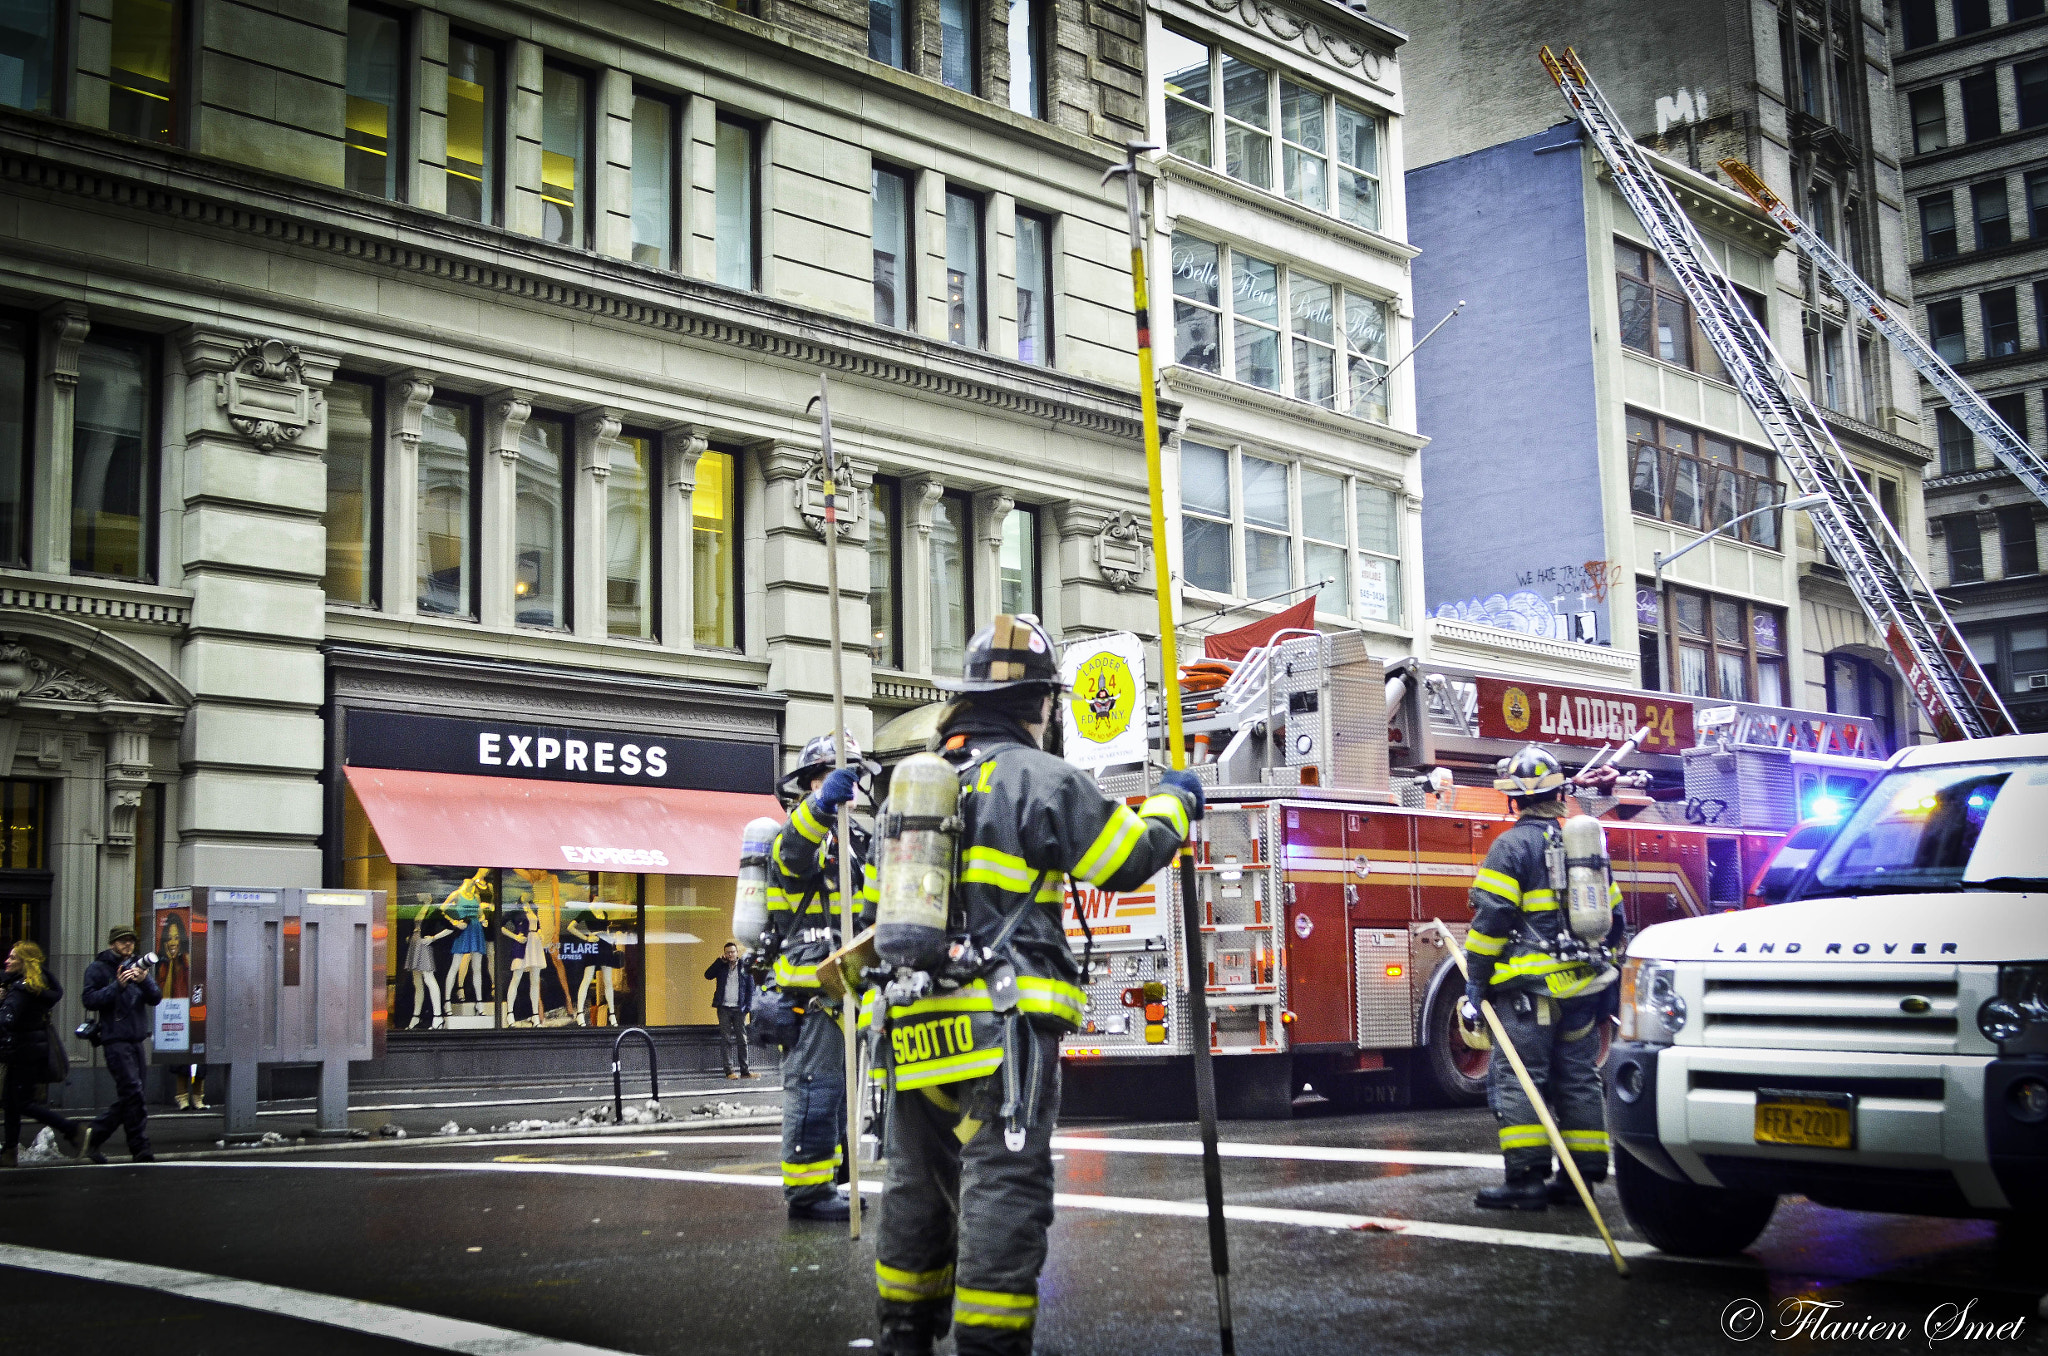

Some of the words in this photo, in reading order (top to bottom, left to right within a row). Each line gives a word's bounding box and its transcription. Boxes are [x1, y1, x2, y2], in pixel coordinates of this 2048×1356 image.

[1171, 246, 1218, 288] Belle
[1234, 264, 1277, 306] Fleur
[1289, 288, 1333, 325] Belle
[1346, 307, 1386, 343] Fleur
[1515, 570, 1533, 586] WE
[1083, 657, 1121, 677] LADDER
[1538, 692, 1637, 740] LADDER
[1645, 705, 1676, 746] 24
[479, 732, 668, 777] EXPRESS
[560, 845, 669, 867] EXPRESS
[229, 892, 261, 901] Phone
[1061, 889, 1116, 920] FDNY
[563, 942, 599, 954] FLARE
[1713, 942, 1802, 954] LAND
[1825, 942, 1958, 955] ROVER
[891, 1014, 974, 1064] SCOTTO
